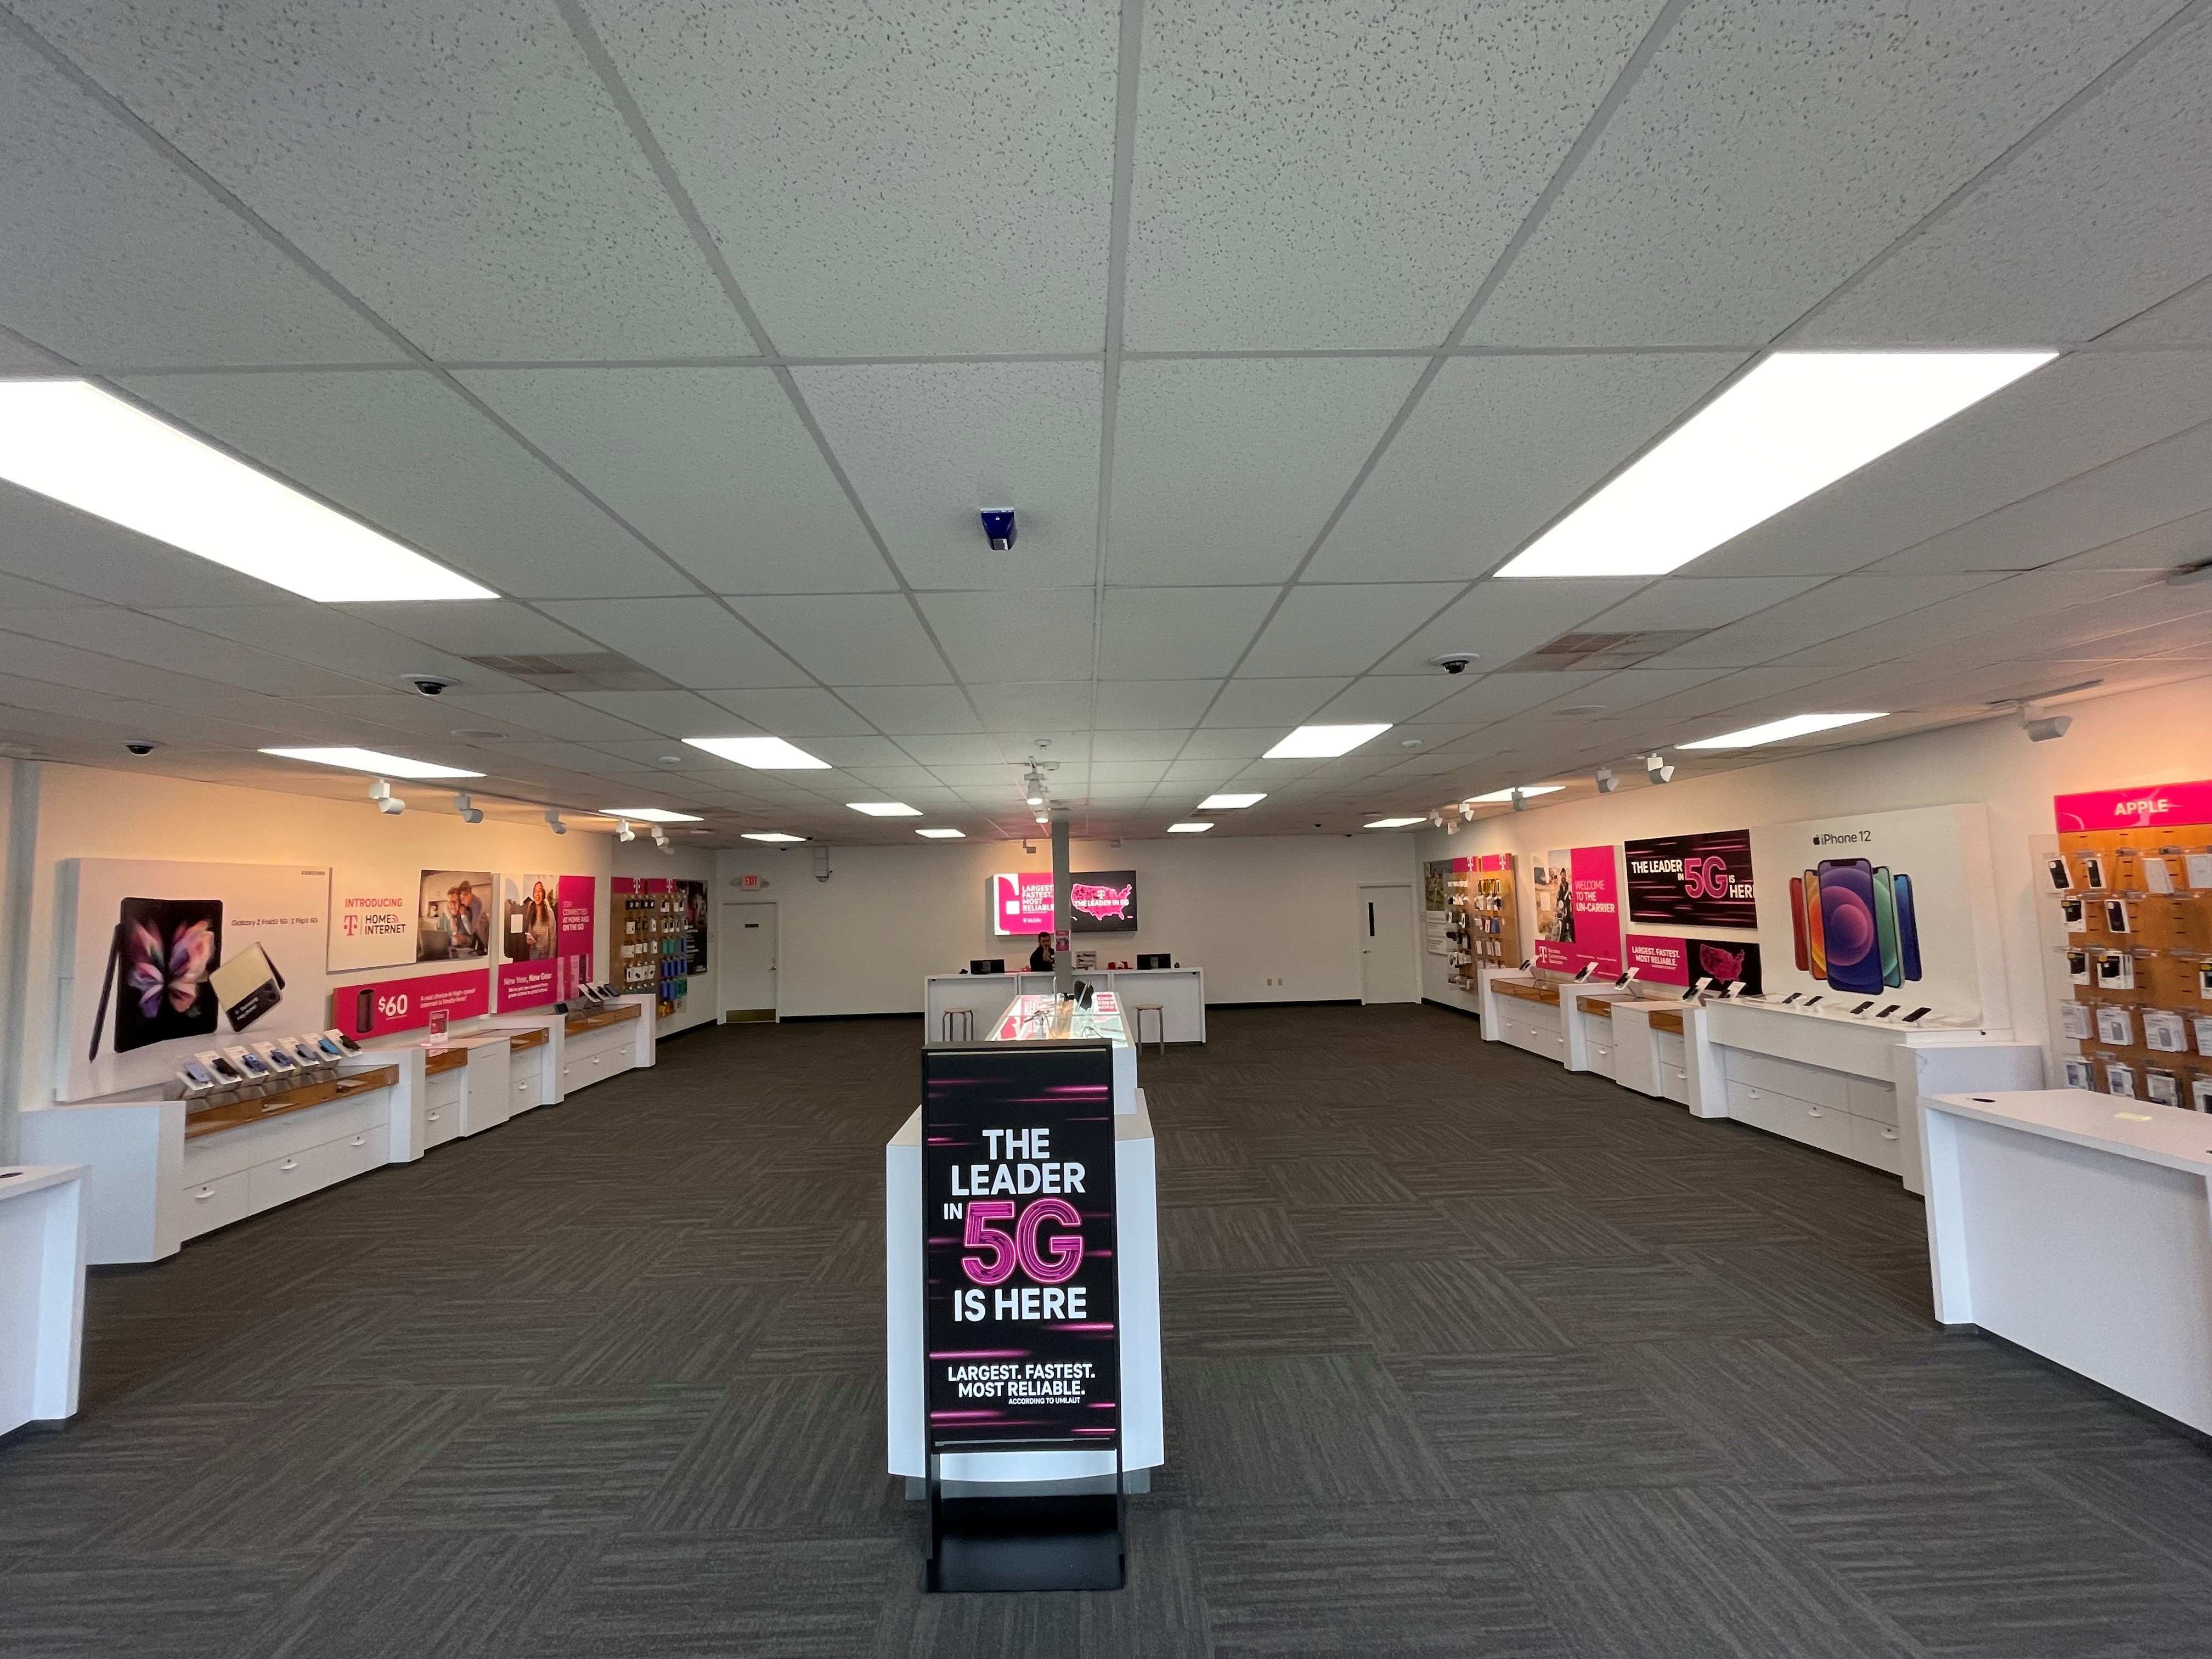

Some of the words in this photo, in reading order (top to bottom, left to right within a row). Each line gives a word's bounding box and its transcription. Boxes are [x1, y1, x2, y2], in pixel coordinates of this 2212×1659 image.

[2114, 799, 2169, 816] APPLE
[1821, 834, 1857, 845] iPhone
[1859, 830, 1871, 842] 12
[1631, 861, 1649, 874] THE
[1649, 859, 1683, 873] LEADER
[1575, 880, 1605, 890] WELCOME
[1684, 856, 1728, 899] 5G
[1729, 874, 1735, 883] IS
[345, 898, 403, 908] INTRODUCING
[1575, 891, 1584, 901] TO
[1584, 891, 1597, 901] THE
[1576, 902, 1615, 913] UN-CARRIER
[365, 914, 391, 924] HOME
[364, 924, 406, 935] INTERNET
[1632, 946, 1655, 955] LARGEST.
[1656, 948, 1680, 958] FASTEST.
[1635, 955, 1650, 963] MOST
[1651, 956, 1678, 966] RELIABLE.
[377, 994, 408, 1017] $60
[982, 1128, 1050, 1160] THE
[951, 1162, 1086, 1196] LEADER
[944, 1203, 963, 1220] IN
[961, 1198, 1085, 1285] 5G
[954, 1288, 986, 1322] IS
[995, 1287, 1087, 1321] HERE
[947, 1364, 1022, 1381] LARGEST.
[1025, 1363, 1096, 1379] FASTEST.
[958, 1381, 1005, 1398] MOST
[1007, 1380, 1086, 1396] RELIABLE.
